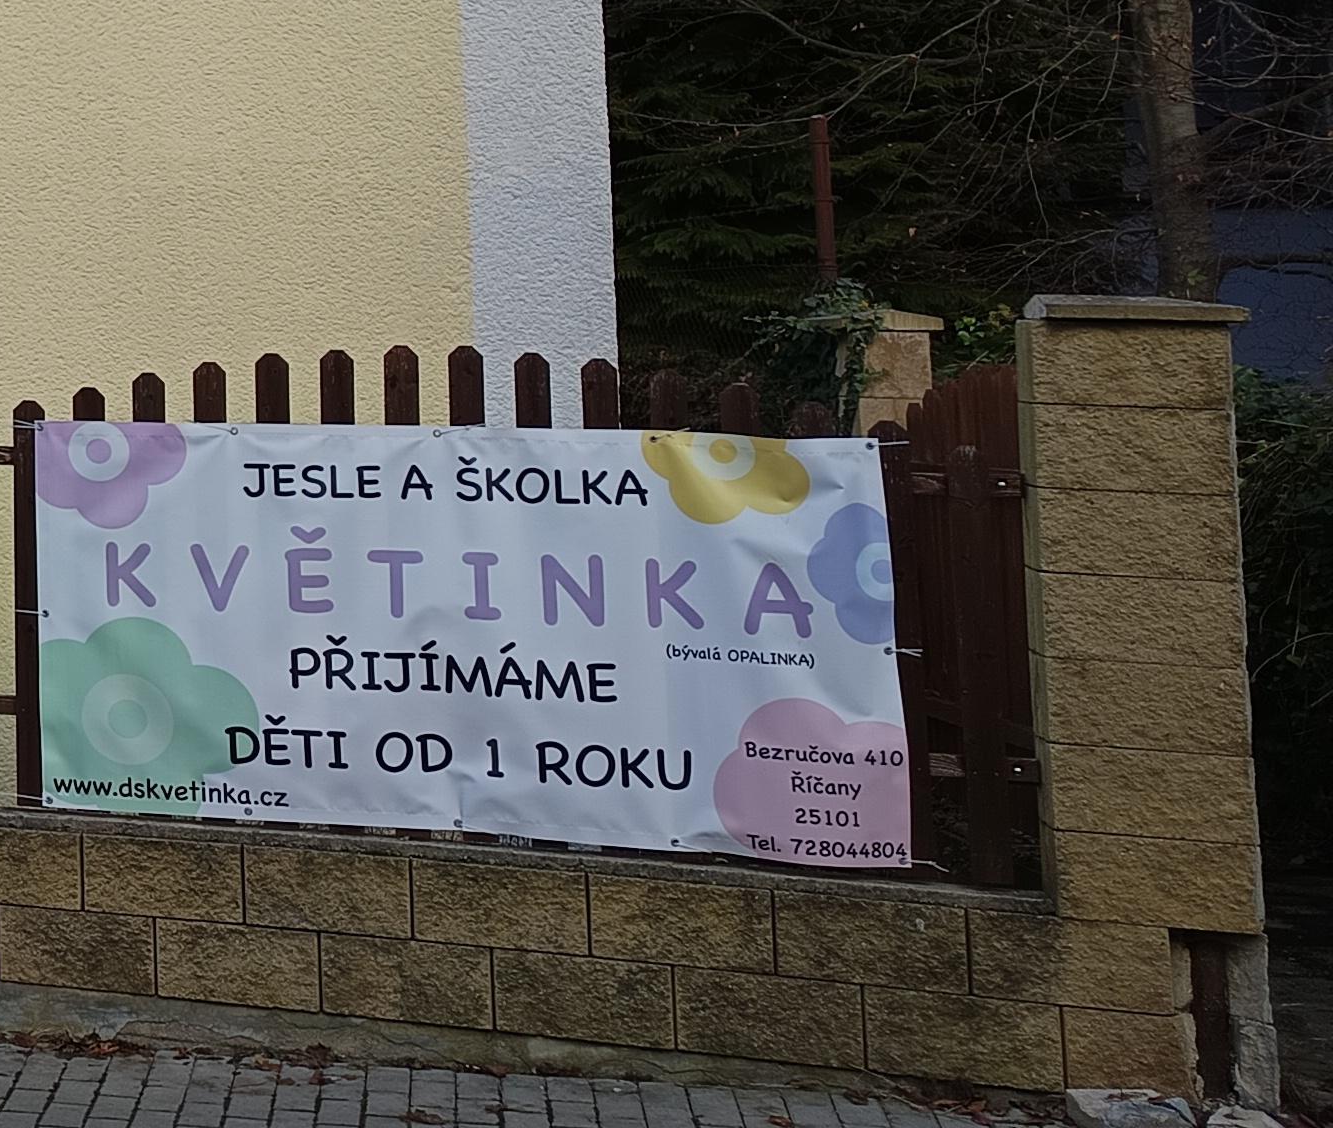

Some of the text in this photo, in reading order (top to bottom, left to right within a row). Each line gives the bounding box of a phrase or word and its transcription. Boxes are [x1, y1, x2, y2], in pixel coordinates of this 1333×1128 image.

[242, 455, 649, 507] JESLE A ŠKOLKA
[105, 525, 814, 639] KVĚTINKA
[288, 634, 618, 703] PŘIJÍMÁME
[665, 644, 816, 669] (bývalá OPALINKA)
[224, 714, 693, 791] DĚTI OD 1 ROKU
[744, 741, 904, 767] Bezručova 410
[53, 776, 290, 807] www.dskvetinka.cz
[790, 770, 862, 801] Říčany
[794, 807, 861, 828] 25101
[746, 834, 909, 859] Tel. 728044804
